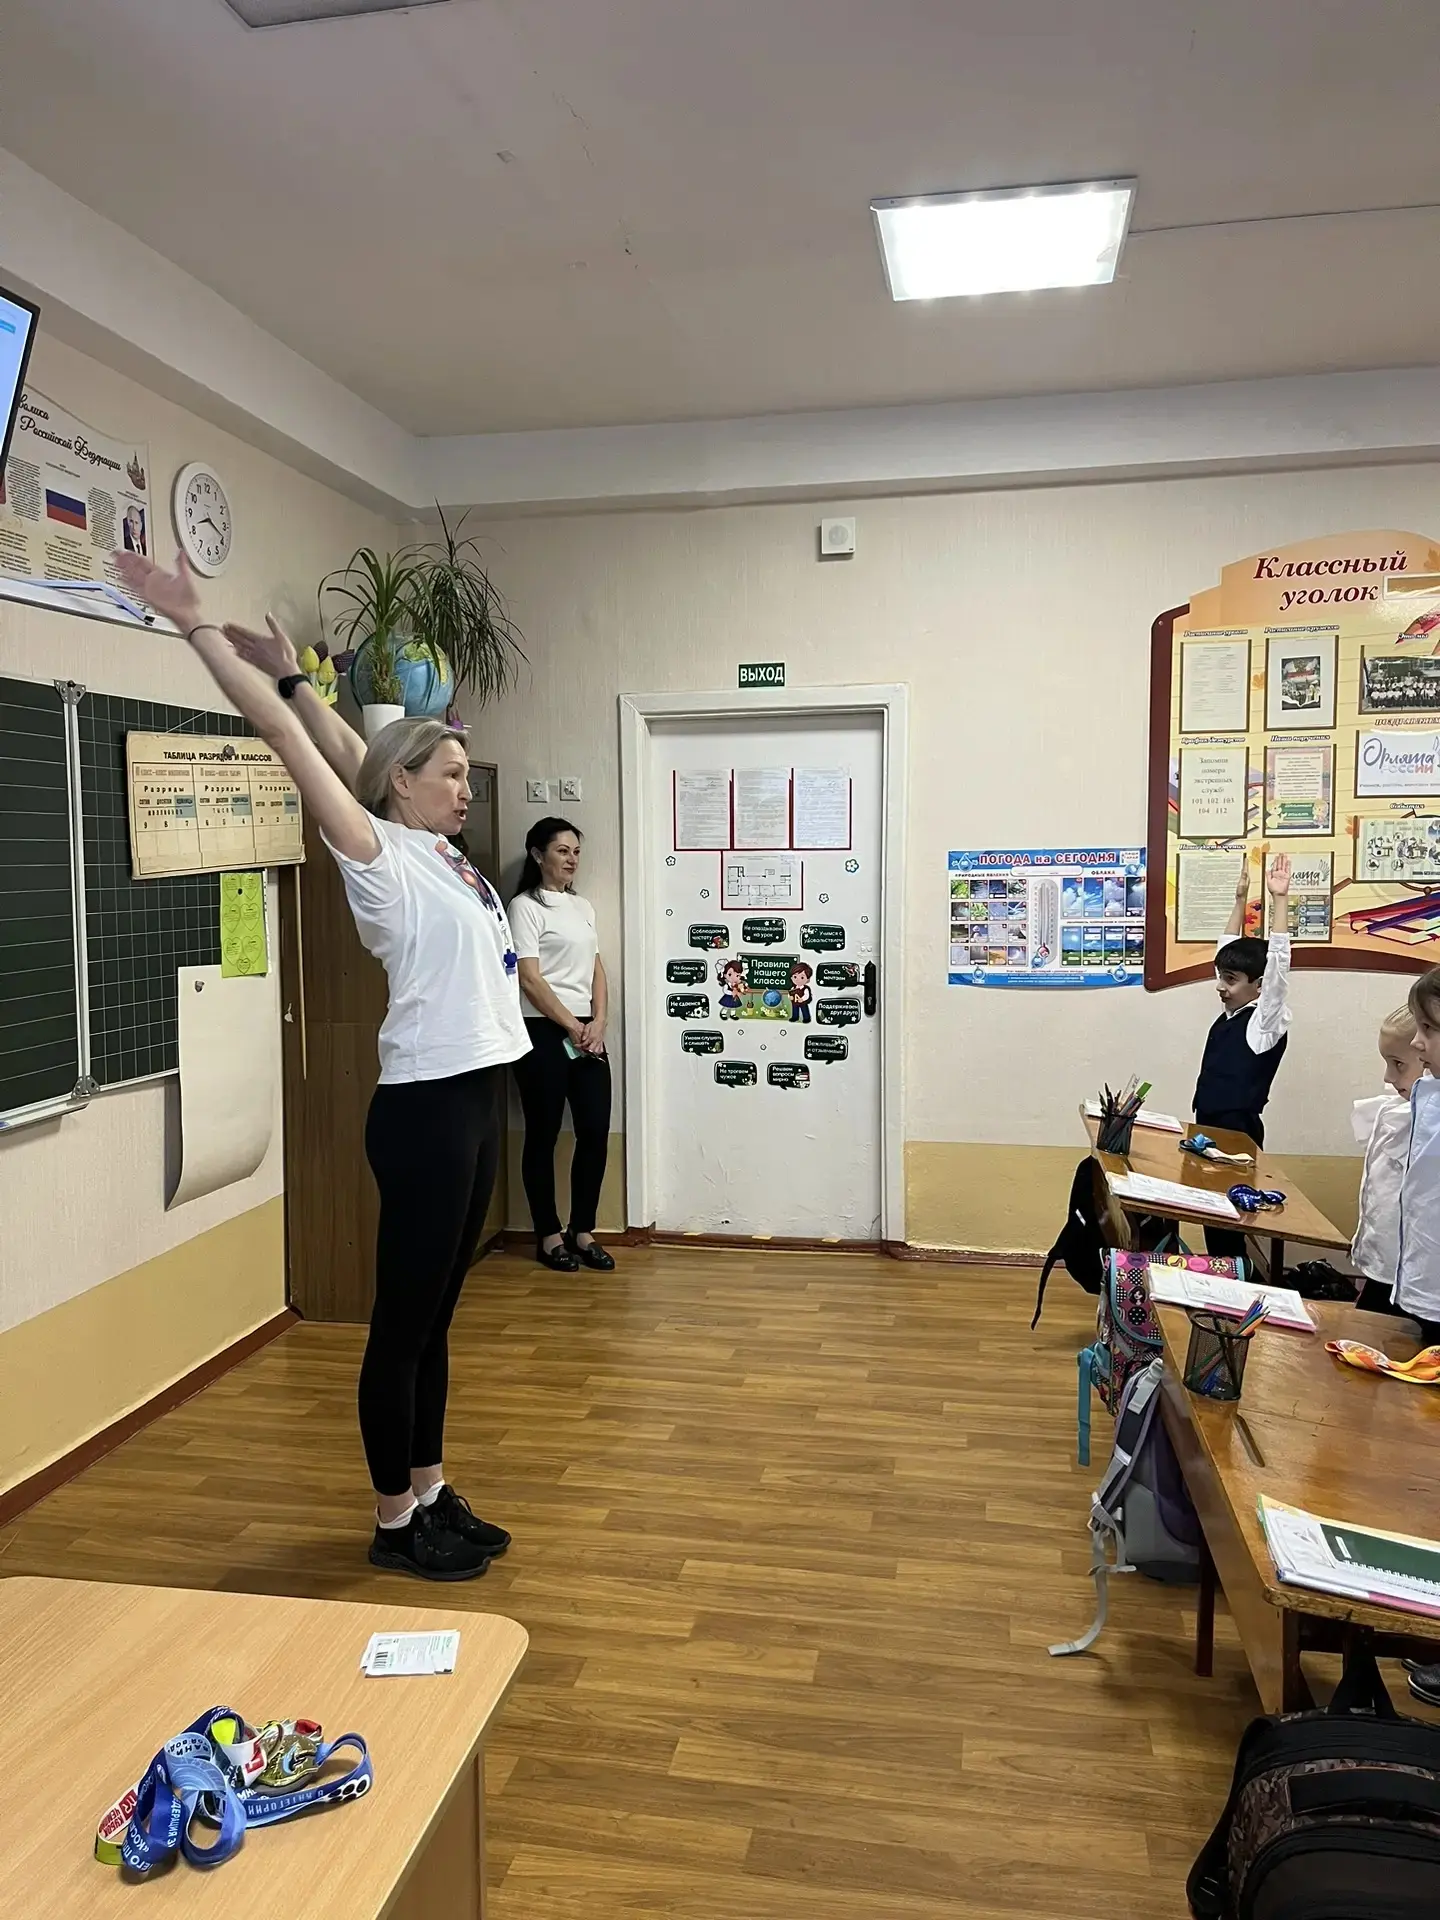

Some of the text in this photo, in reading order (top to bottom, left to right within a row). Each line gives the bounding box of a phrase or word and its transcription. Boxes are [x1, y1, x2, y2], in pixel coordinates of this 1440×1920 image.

[20, 415, 73, 450] Российской
[74, 436, 121, 471] Федерации
[196, 484, 202, 494] 11
[204, 482, 211, 494] 12
[190, 492, 198, 504] 10
[214, 492, 218, 502] 1
[188, 508, 193, 518] 9
[192, 525, 196, 535] 8
[222, 522, 227, 532] 3
[199, 540, 204, 548] 7
[206, 546, 212, 556] 6
[215, 546, 220, 555] 5
[1253, 550, 1408, 580] Классный
[1279, 585, 1379, 610] уголок
[740, 666, 784, 684] ВЫХОД
[163, 752, 196, 762] ТАБЛИЦА
[242, 753, 272, 762] КЛАССОВ
[1364, 738, 1435, 770] Орлята
[1380, 764, 1434, 774] ОССИИ
[980, 854, 1031, 866] ПОГОДА
[1035, 855, 1050, 864] на
[1056, 852, 1116, 864] СЕГОДНЯ
[751, 960, 790, 968] Правила
[248, 1792, 312, 1815] КАТЕГОРИИ
[168, 1796, 182, 1838] ДЕРАЦИЯ
[130, 1855, 153, 1871] ЕГО
